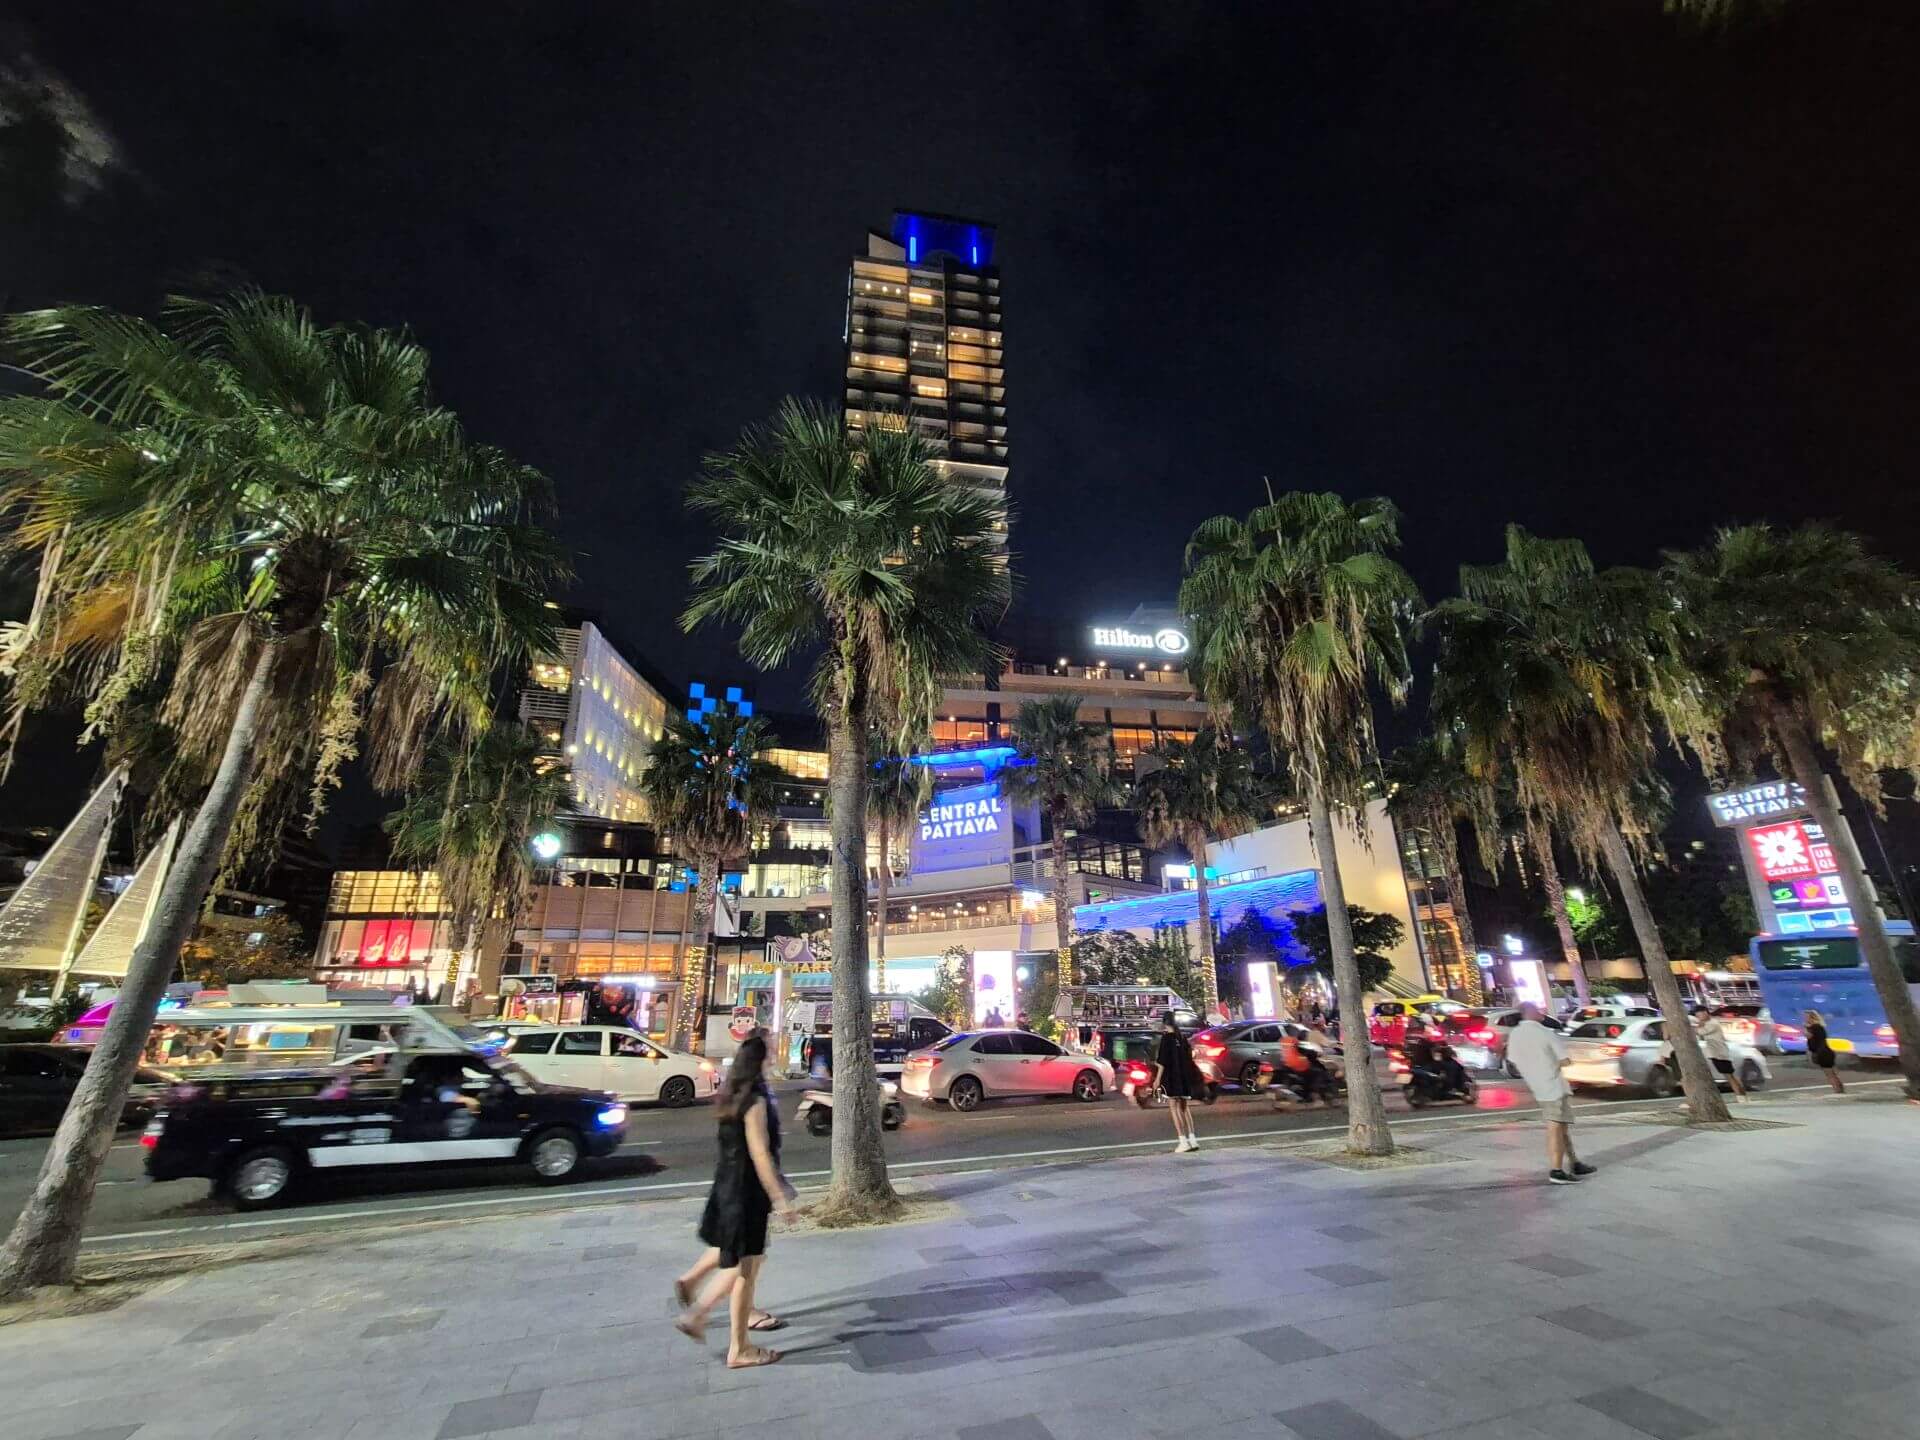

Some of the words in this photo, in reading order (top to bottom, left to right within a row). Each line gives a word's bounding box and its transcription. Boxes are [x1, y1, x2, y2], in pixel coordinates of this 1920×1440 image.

[1093, 628, 1154, 648] Hilton
[922, 815, 998, 841] PATTAYA
[1767, 864, 1812, 877] CENTRAL
